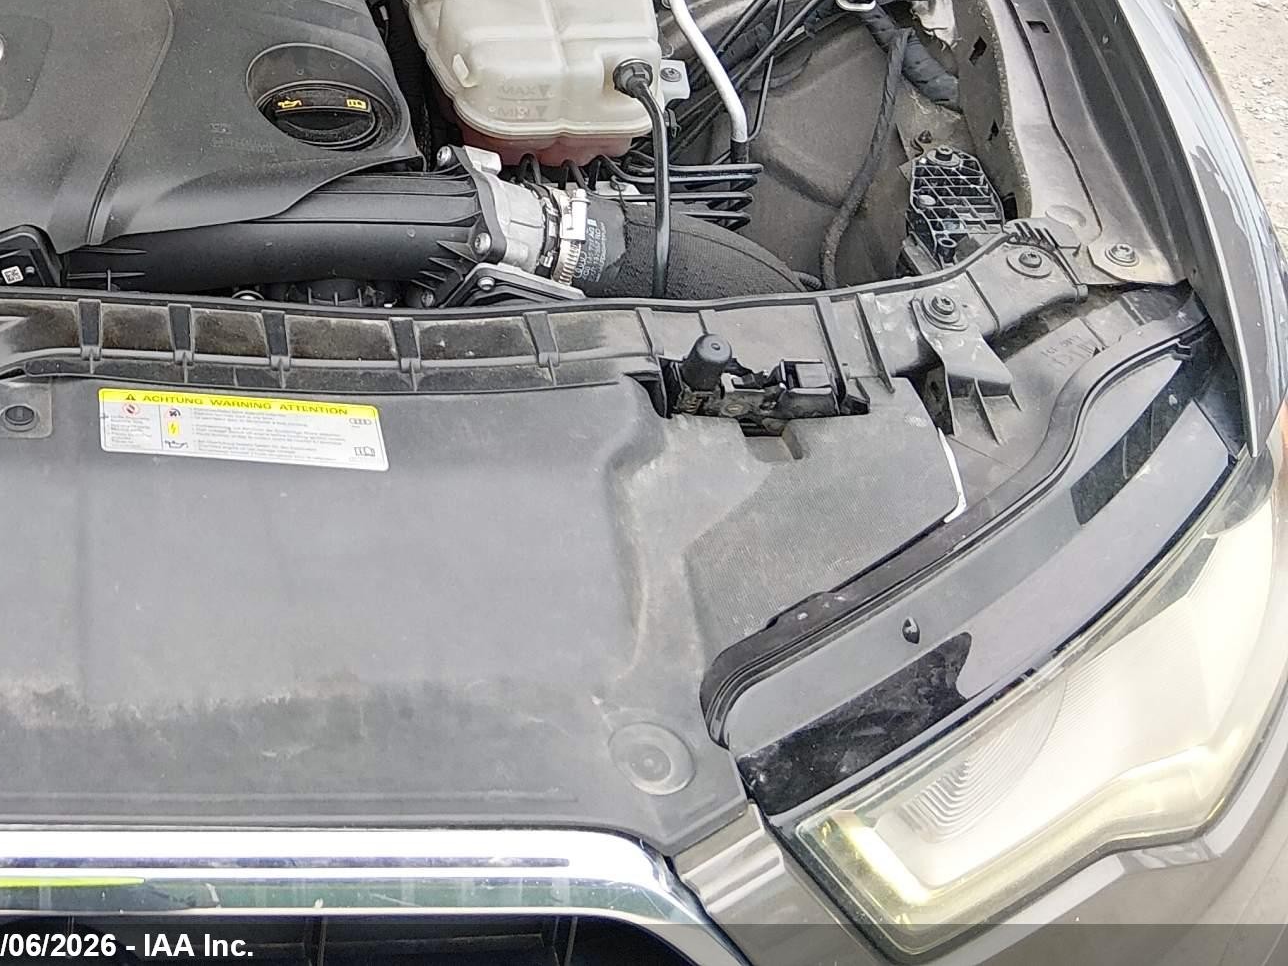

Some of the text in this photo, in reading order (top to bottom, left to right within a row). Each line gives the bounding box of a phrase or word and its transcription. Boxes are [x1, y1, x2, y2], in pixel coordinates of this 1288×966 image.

[142, 395, 348, 415] ACHTUNG WARNING ATTENTION
